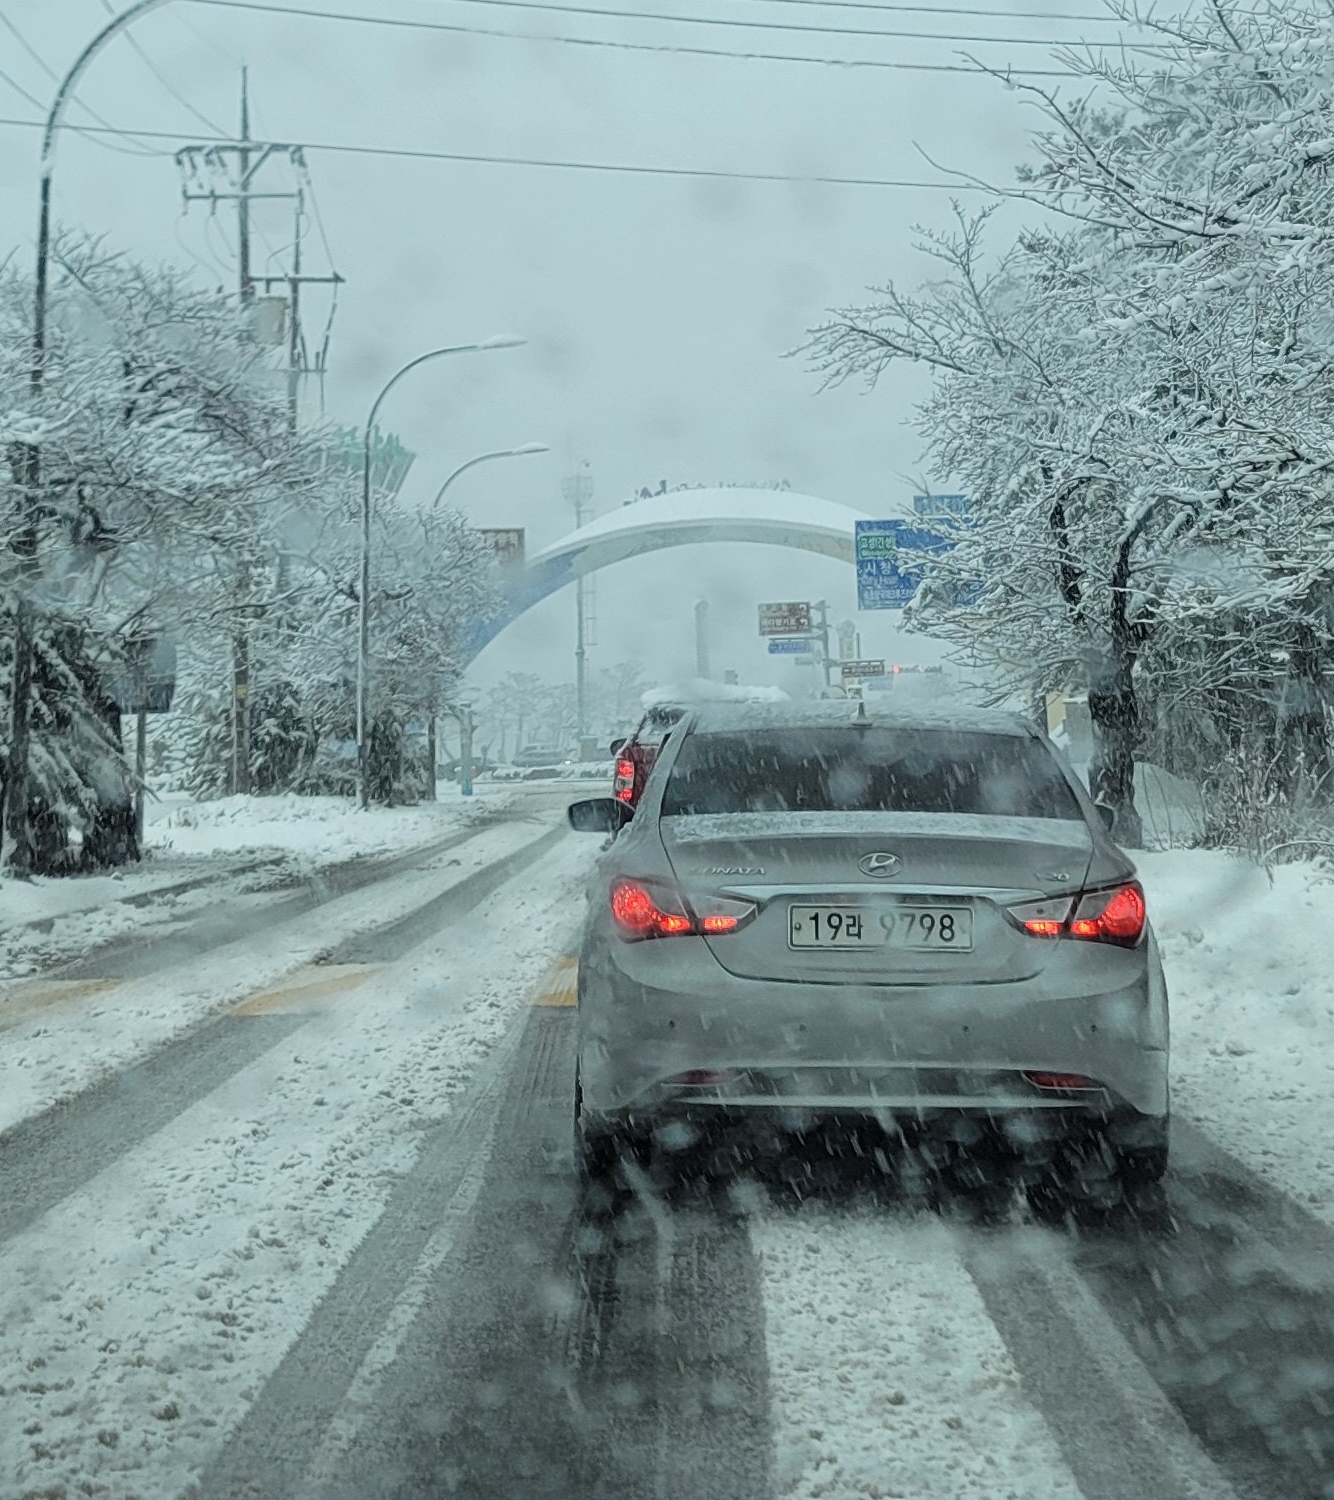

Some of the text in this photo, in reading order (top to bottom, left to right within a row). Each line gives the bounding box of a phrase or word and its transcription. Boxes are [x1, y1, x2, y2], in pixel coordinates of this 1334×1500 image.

[689, 867, 766, 875] ONATA
[808, 911, 956, 943] 19라 9798
